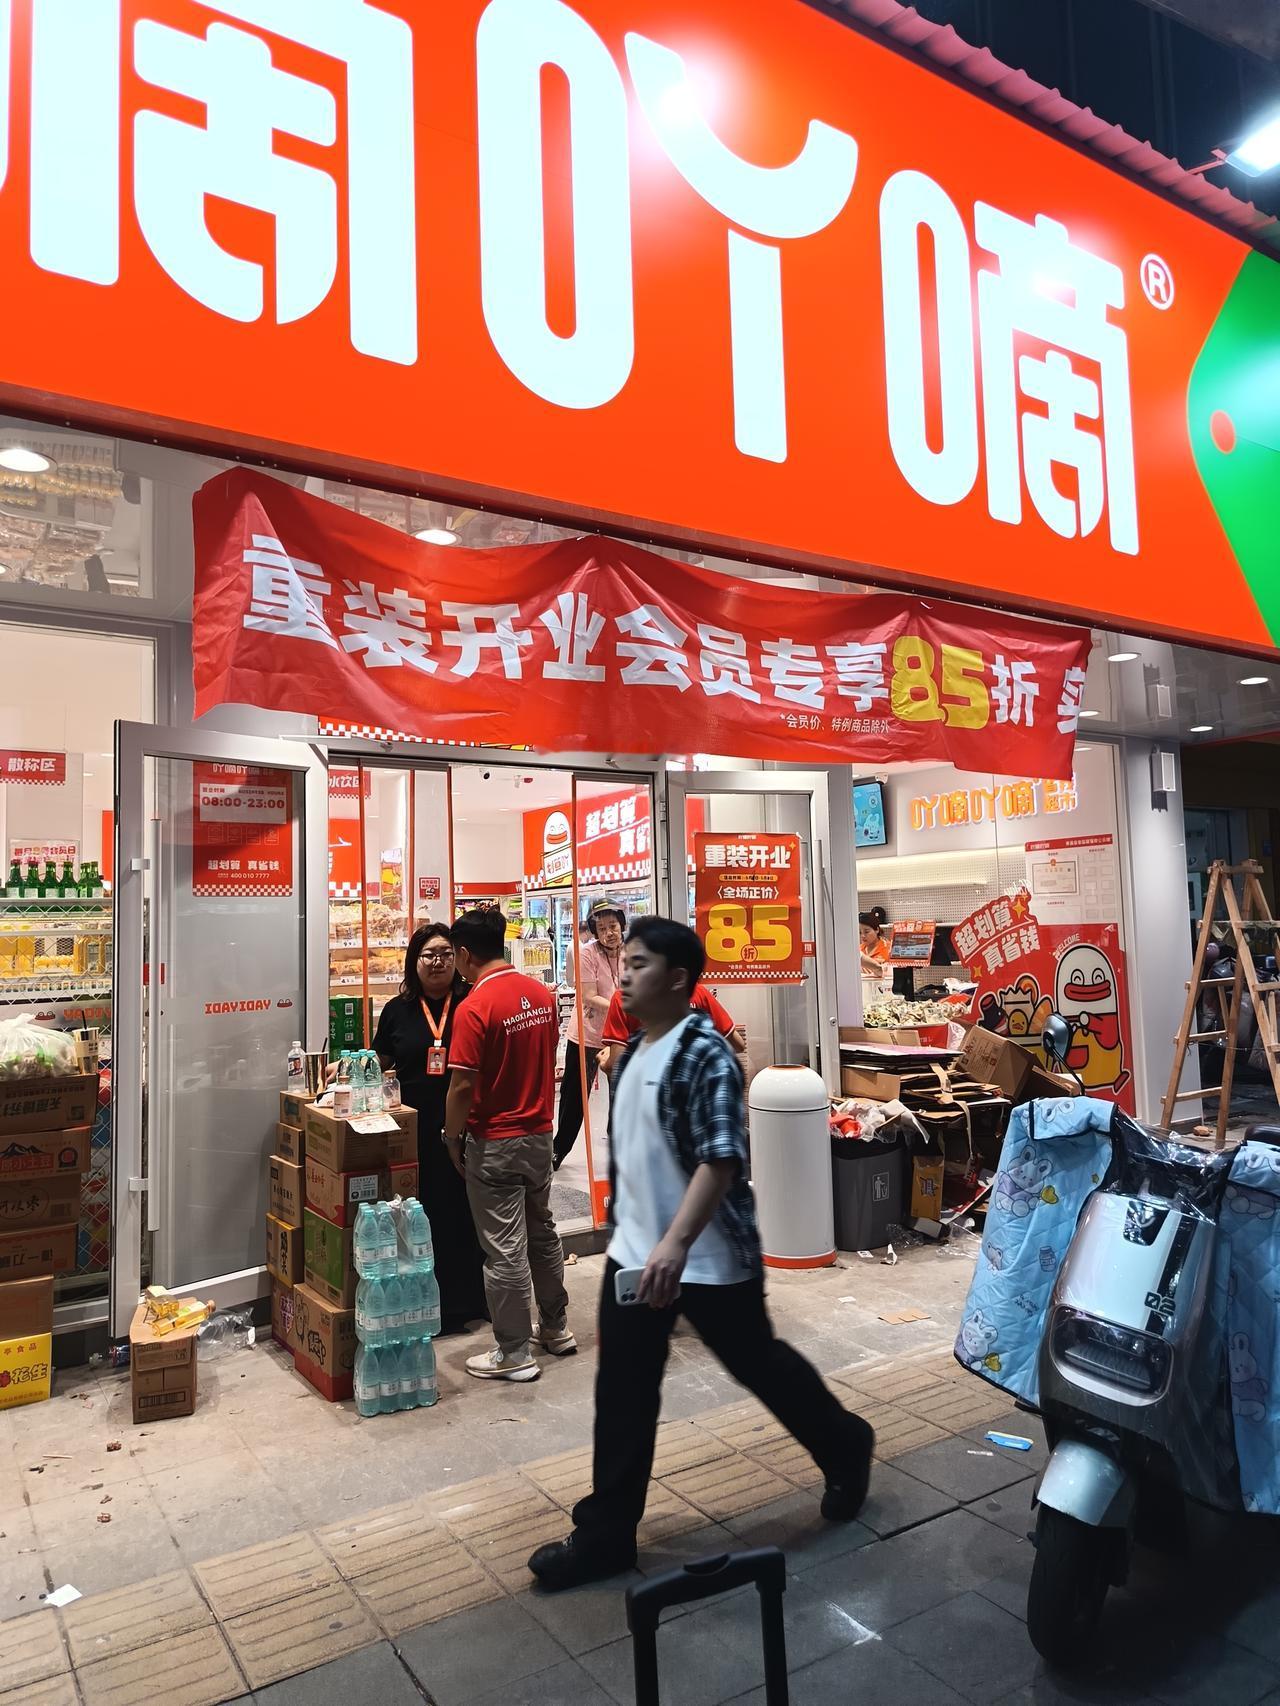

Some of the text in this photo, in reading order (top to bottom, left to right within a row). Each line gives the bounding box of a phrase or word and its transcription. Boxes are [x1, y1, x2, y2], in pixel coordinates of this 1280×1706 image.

[8, 757, 56, 772] 散称区
[202, 796, 285, 809] 08:00-23:00
[619, 822, 650, 858] 真省
[208, 860, 280, 871] 超划算 真省钱
[705, 844, 791, 868] 重装开业
[706, 904, 792, 962] 85 折
[955, 901, 1013, 958] 超划算
[982, 924, 1040, 975] 真省钱
